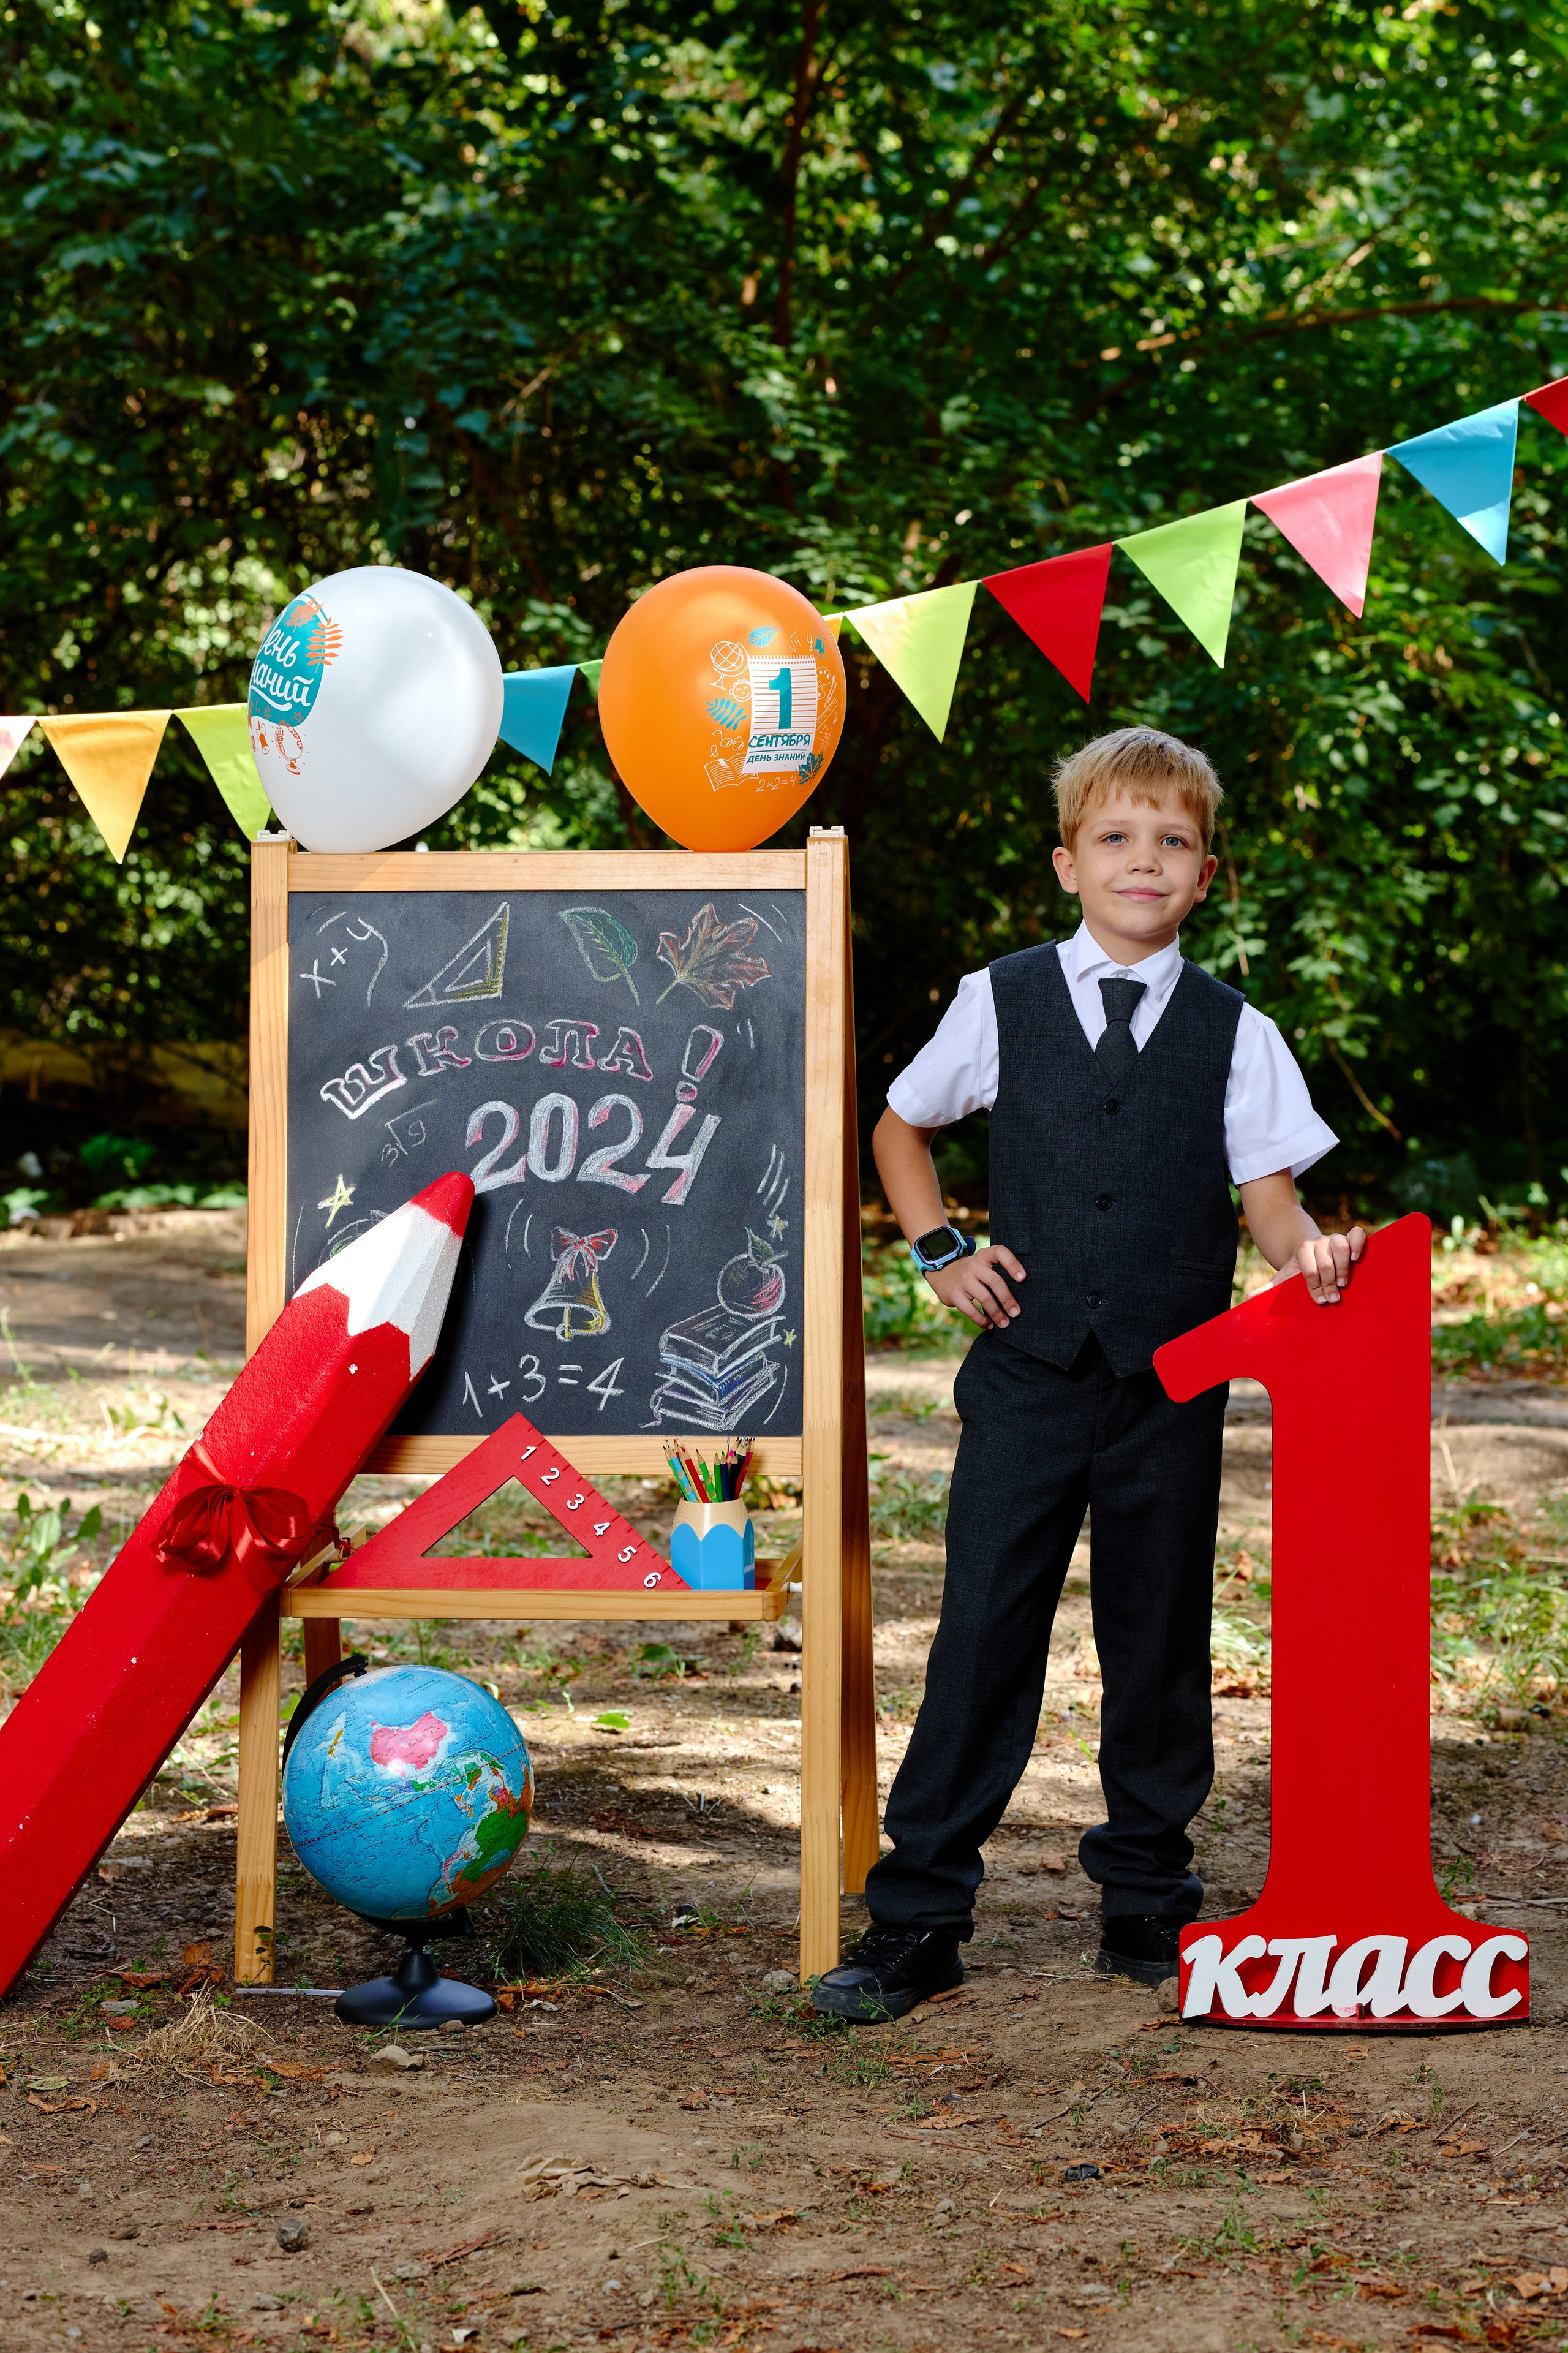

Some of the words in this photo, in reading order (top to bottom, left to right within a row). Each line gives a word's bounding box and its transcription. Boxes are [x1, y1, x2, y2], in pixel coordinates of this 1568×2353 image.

[748, 733, 811, 749] СЕНТЯБРЯ
[768, 668, 792, 730] 1
[746, 754, 772, 765] ДЕНЬ
[773, 752, 805, 761] ЗНАНИЙ
[466, 1092, 723, 1206] 2024
[521, 1446, 537, 1460] 1
[540, 1467, 560, 1486] 2
[567, 1494, 585, 1510] 3
[592, 1522, 611, 1536] 4
[617, 1545, 637, 1562] 5
[643, 1571, 662, 1588] 6
[1153, 1212, 1531, 2022] 1
